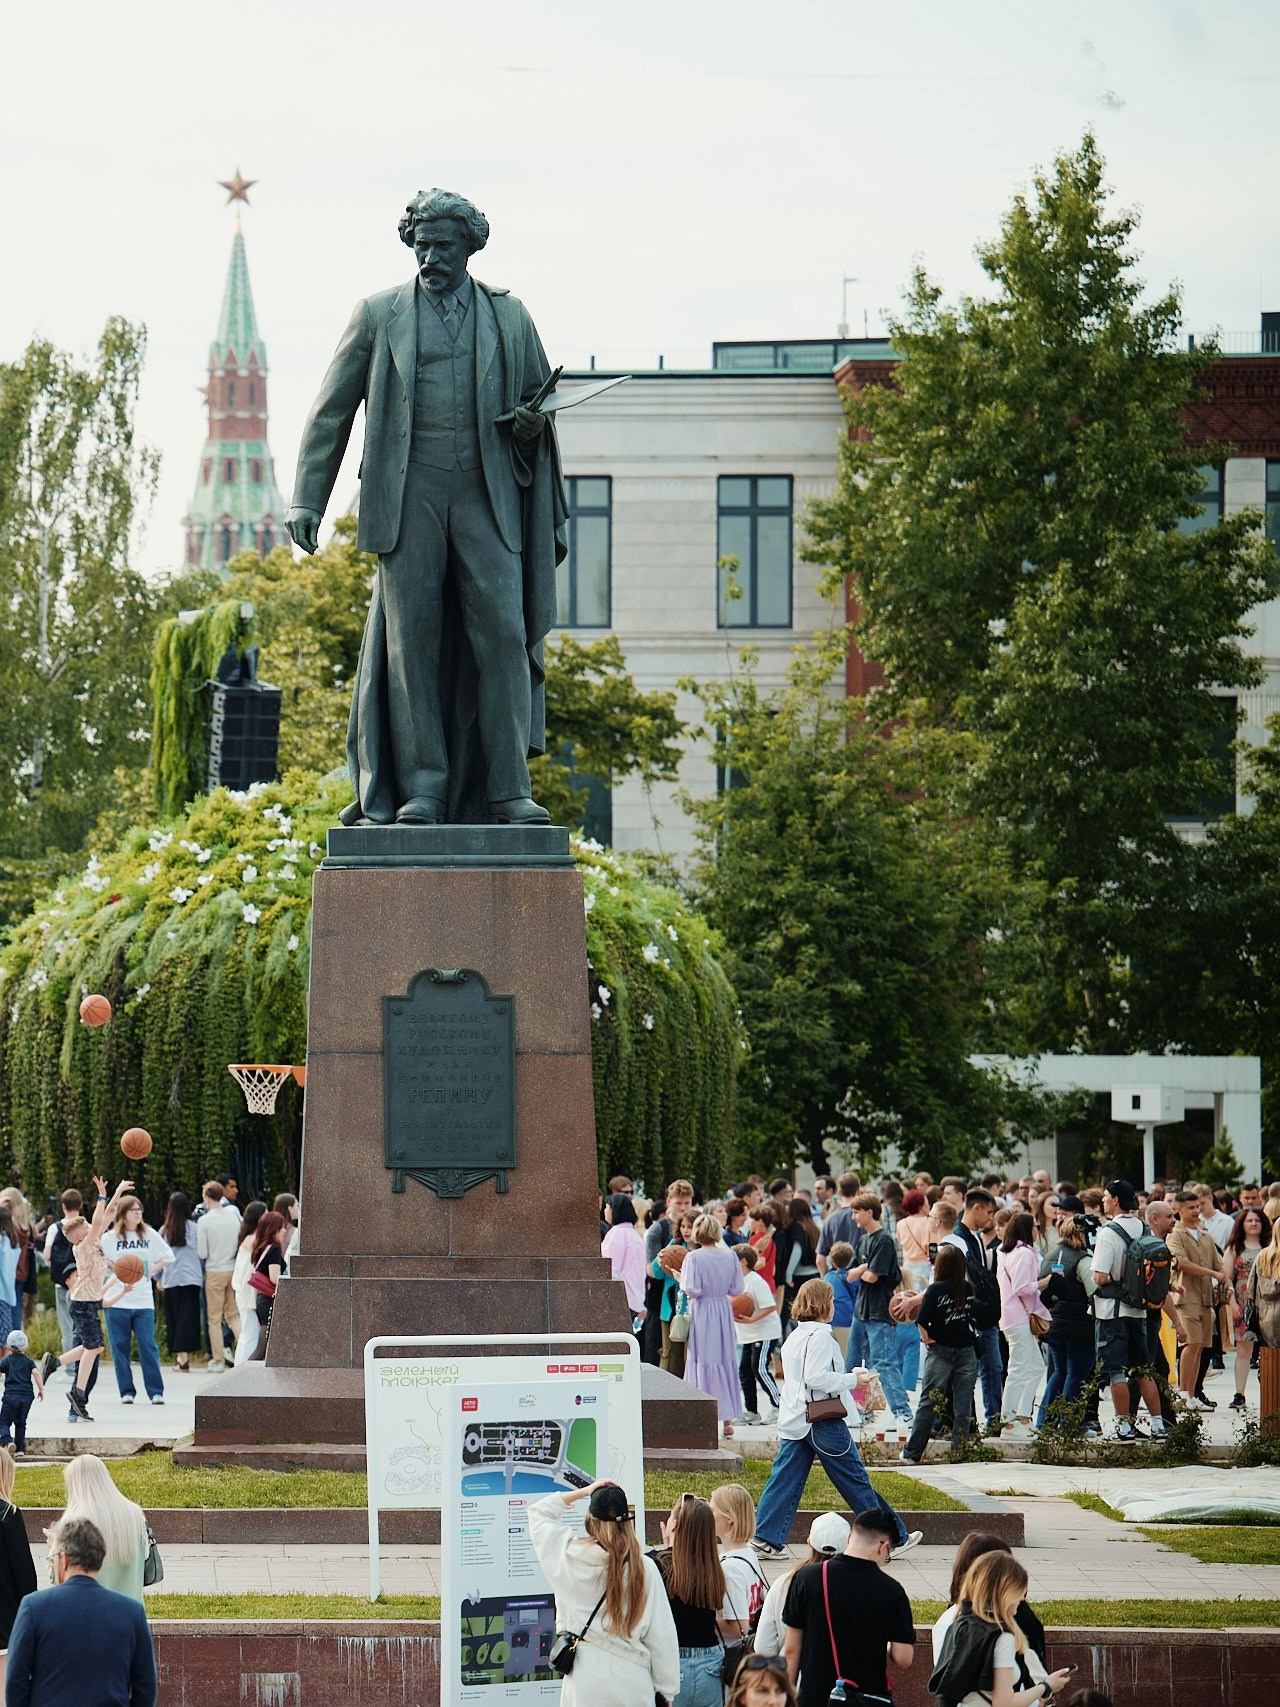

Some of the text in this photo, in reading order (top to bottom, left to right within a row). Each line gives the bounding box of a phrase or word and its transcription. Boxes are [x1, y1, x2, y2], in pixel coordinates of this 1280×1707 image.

[409, 1013, 492, 1024] ВЕЛИКОМУ
[409, 1029, 492, 1040] РУССКОМУ
[397, 1045, 503, 1057] ХУДОЖНИКУ
[409, 1088, 493, 1104] РЕПИНУ
[116, 1239, 150, 1251] FRANK
